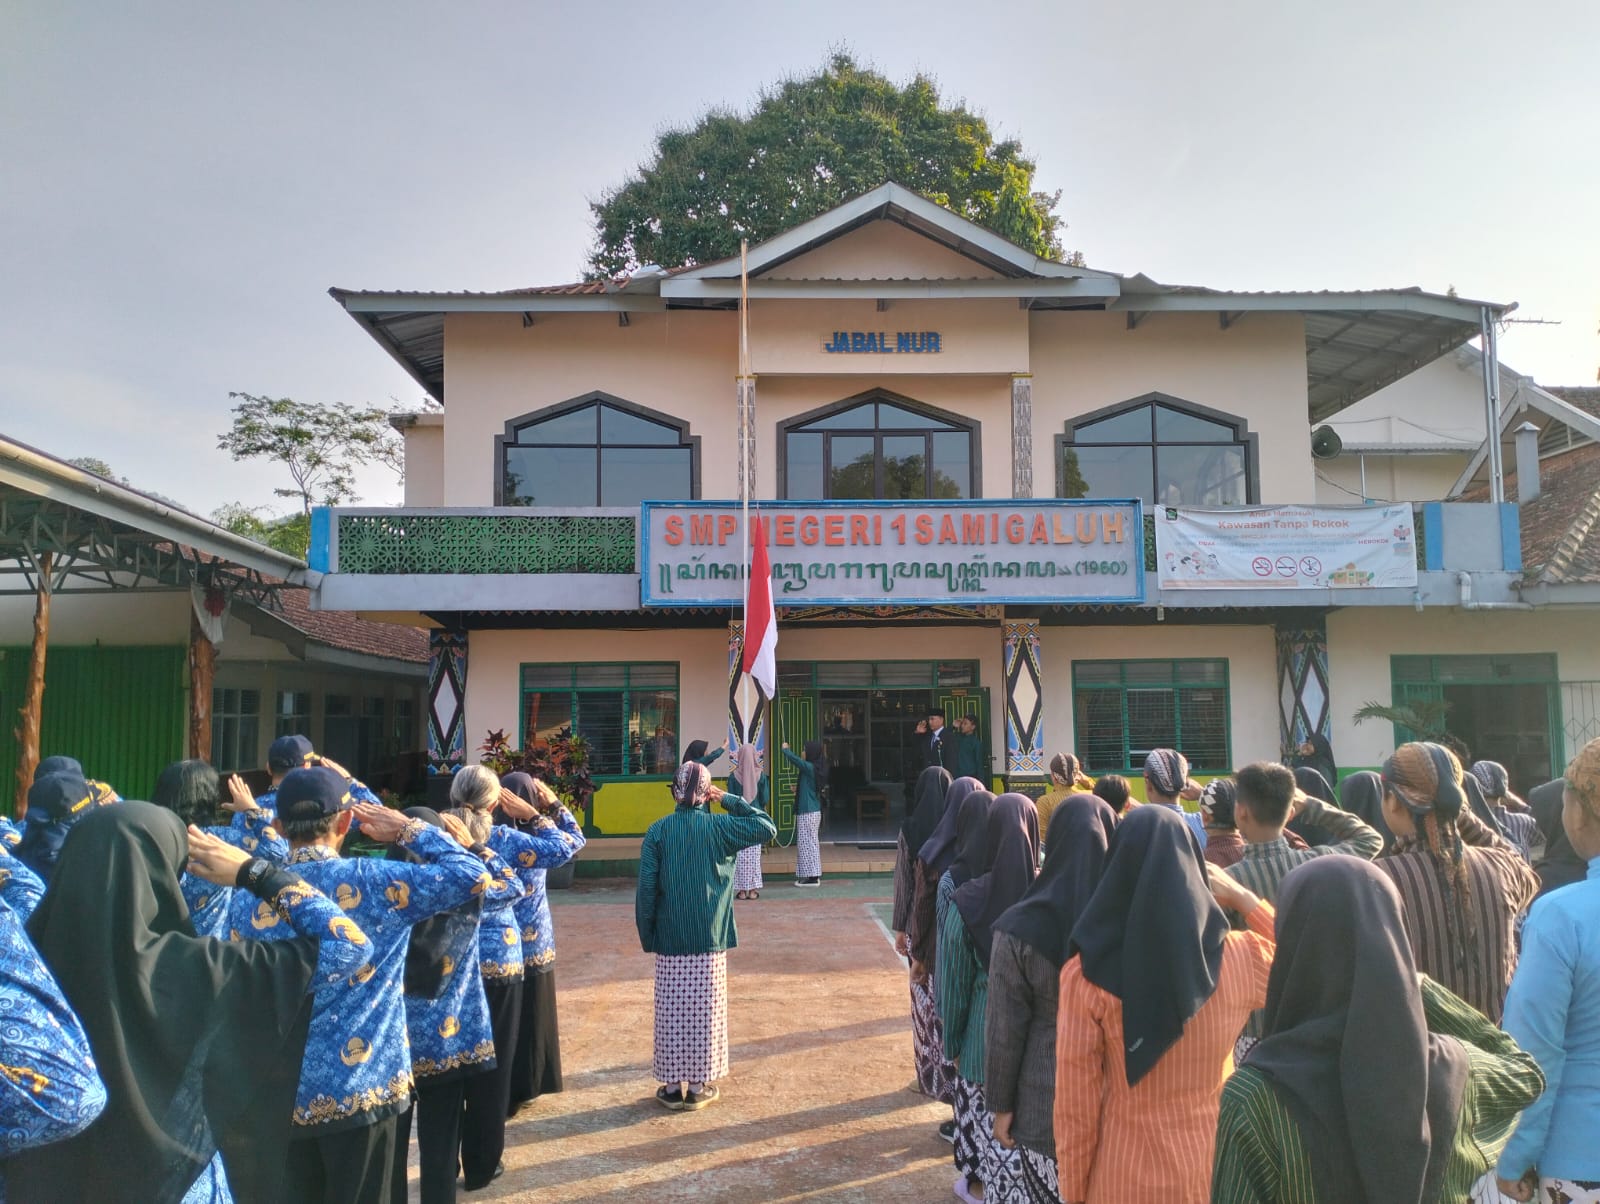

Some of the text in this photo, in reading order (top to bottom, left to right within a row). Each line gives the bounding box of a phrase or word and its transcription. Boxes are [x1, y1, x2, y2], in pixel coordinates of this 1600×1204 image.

[825, 331, 941, 353] JABAL NUR
[1249, 510, 1272, 518] Anda
[664, 511, 1124, 547] SMP NEGERI 1 SAMIGALUH
[1218, 518, 1349, 530] Kawasan Tanpa Rokok
[1074, 560, 1128, 576] (1960)
